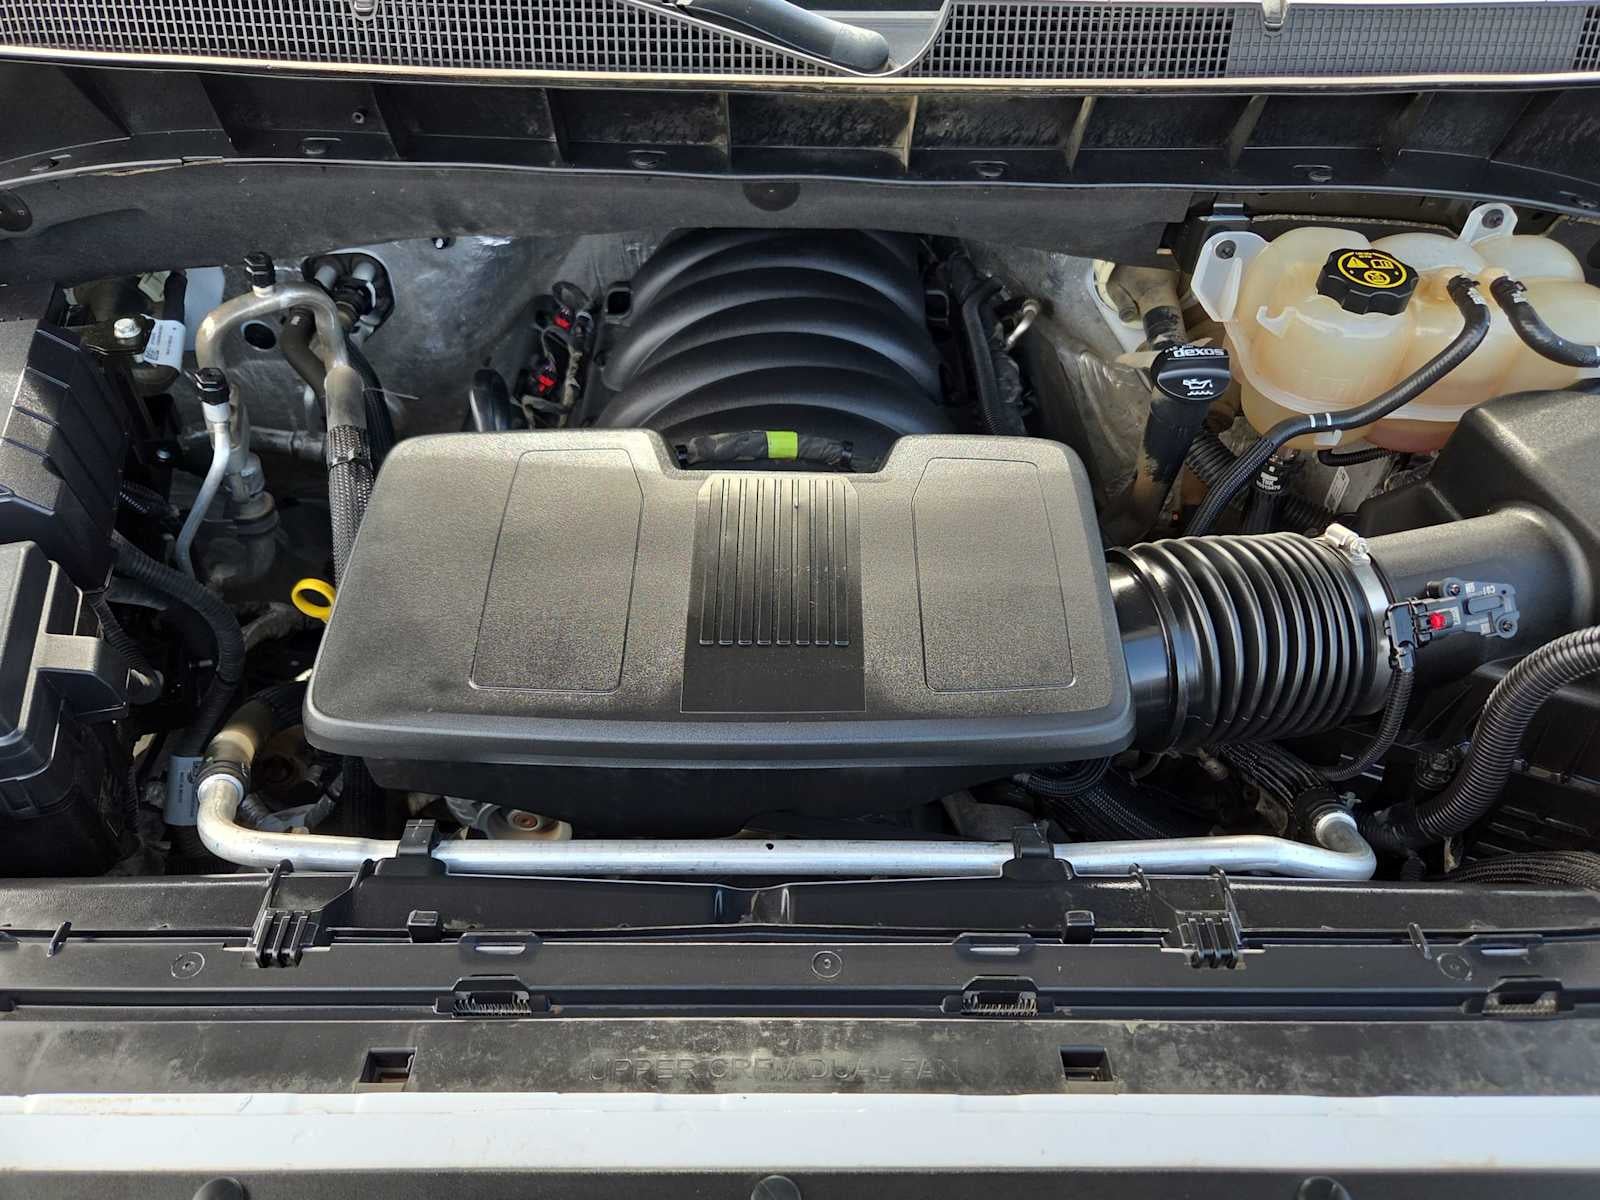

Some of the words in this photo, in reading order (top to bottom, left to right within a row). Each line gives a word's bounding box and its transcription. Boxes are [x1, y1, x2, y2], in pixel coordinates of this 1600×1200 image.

[1173, 347, 1224, 357] dexos
[589, 1057, 698, 1081] UPPER
[806, 1057, 893, 1081] DUAL
[900, 1056, 963, 1081] FAN
